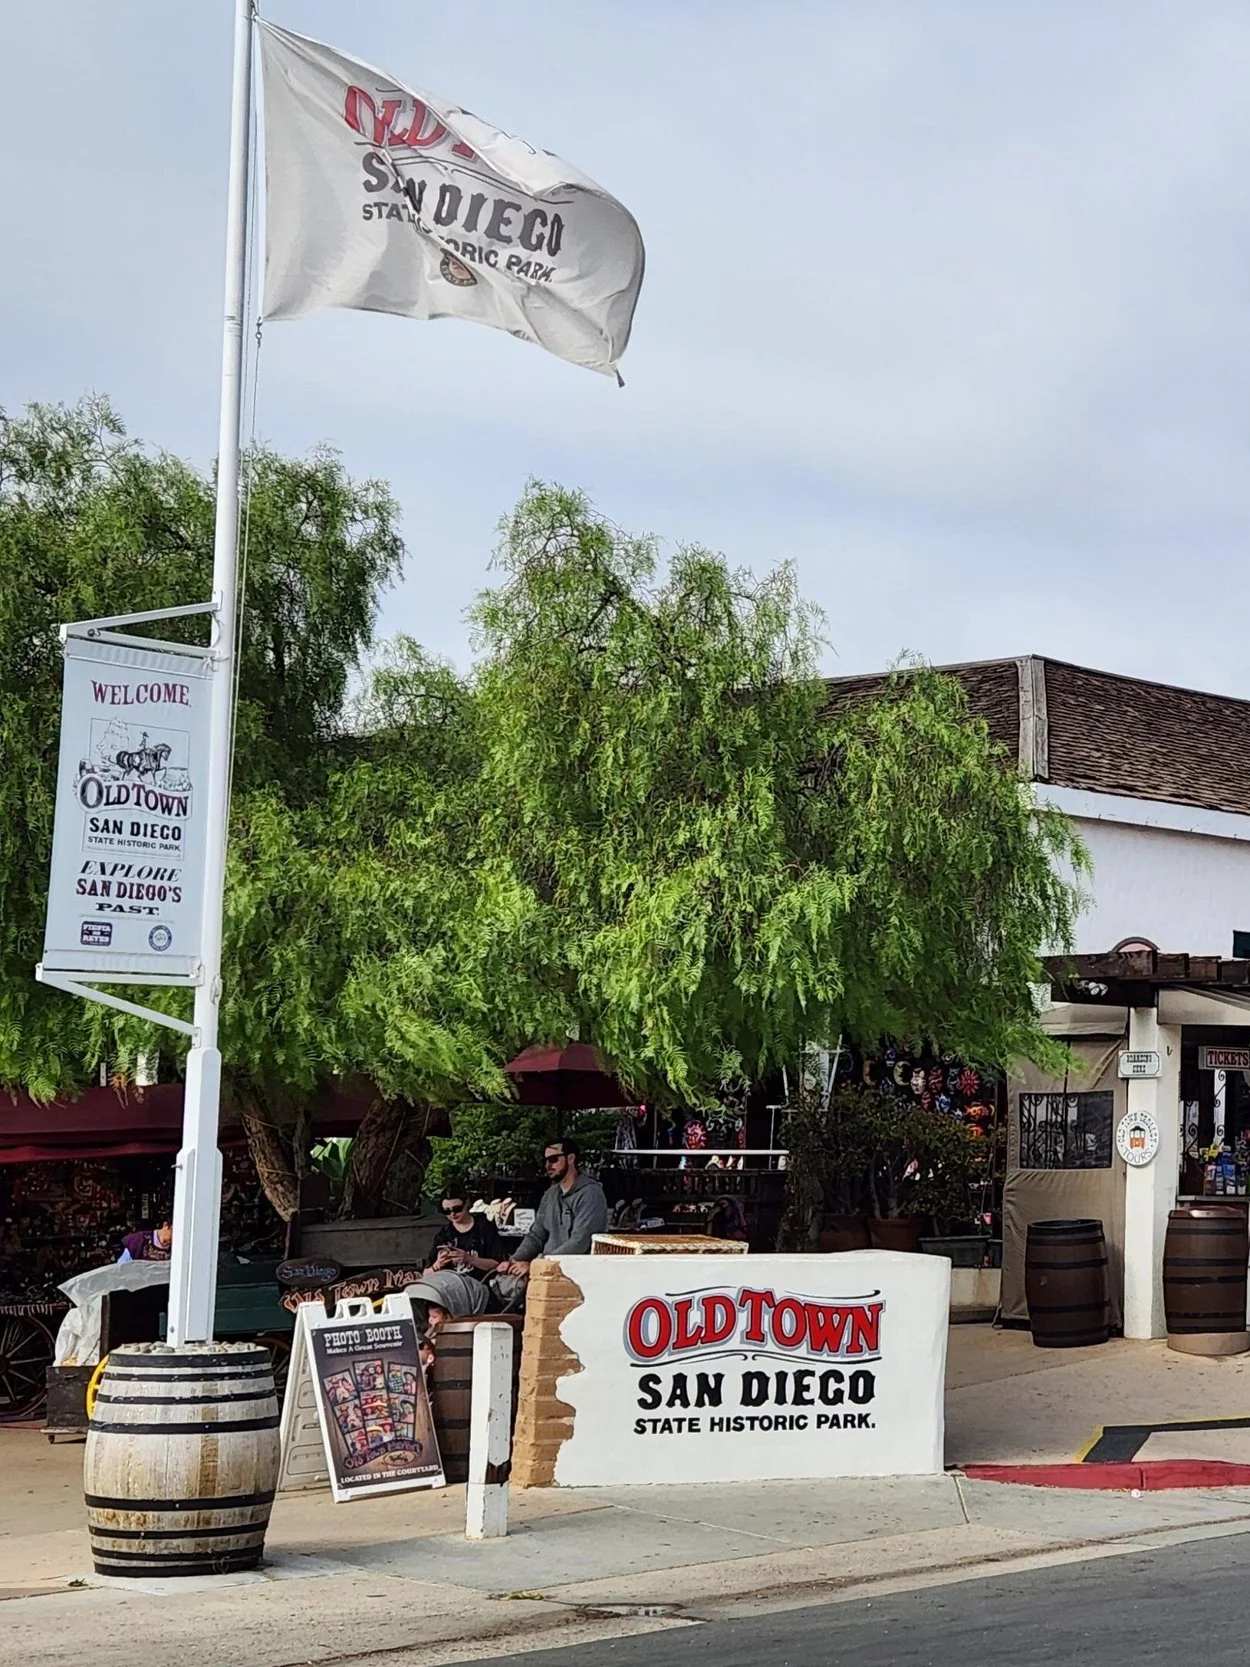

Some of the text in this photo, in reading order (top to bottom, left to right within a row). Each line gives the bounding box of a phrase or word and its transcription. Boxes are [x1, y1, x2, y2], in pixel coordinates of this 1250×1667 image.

[432, 183, 565, 257] DIEGO
[89, 817, 182, 841] SAN DIEGO
[88, 835, 115, 845] STATE
[117, 840, 157, 850] HISTORIC
[79, 860, 182, 883] EXPLORE
[76, 878, 183, 904] SAN DIEGO'S
[1207, 1050, 1249, 1066] TICKETS
[328, 1278, 380, 1300] Town
[323, 1325, 403, 1347] PHOTO BOOTH
[354, 1344, 372, 1352] Great
[373, 1341, 403, 1350] Souvenir
[637, 1369, 876, 1411] SAN DIEGO
[633, 1412, 876, 1436] STATE HISTORIC PARK.
[340, 1474, 372, 1484] LOCATED
[382, 1470, 395, 1478] THE
[397, 1464, 439, 1475] COURTYARD
